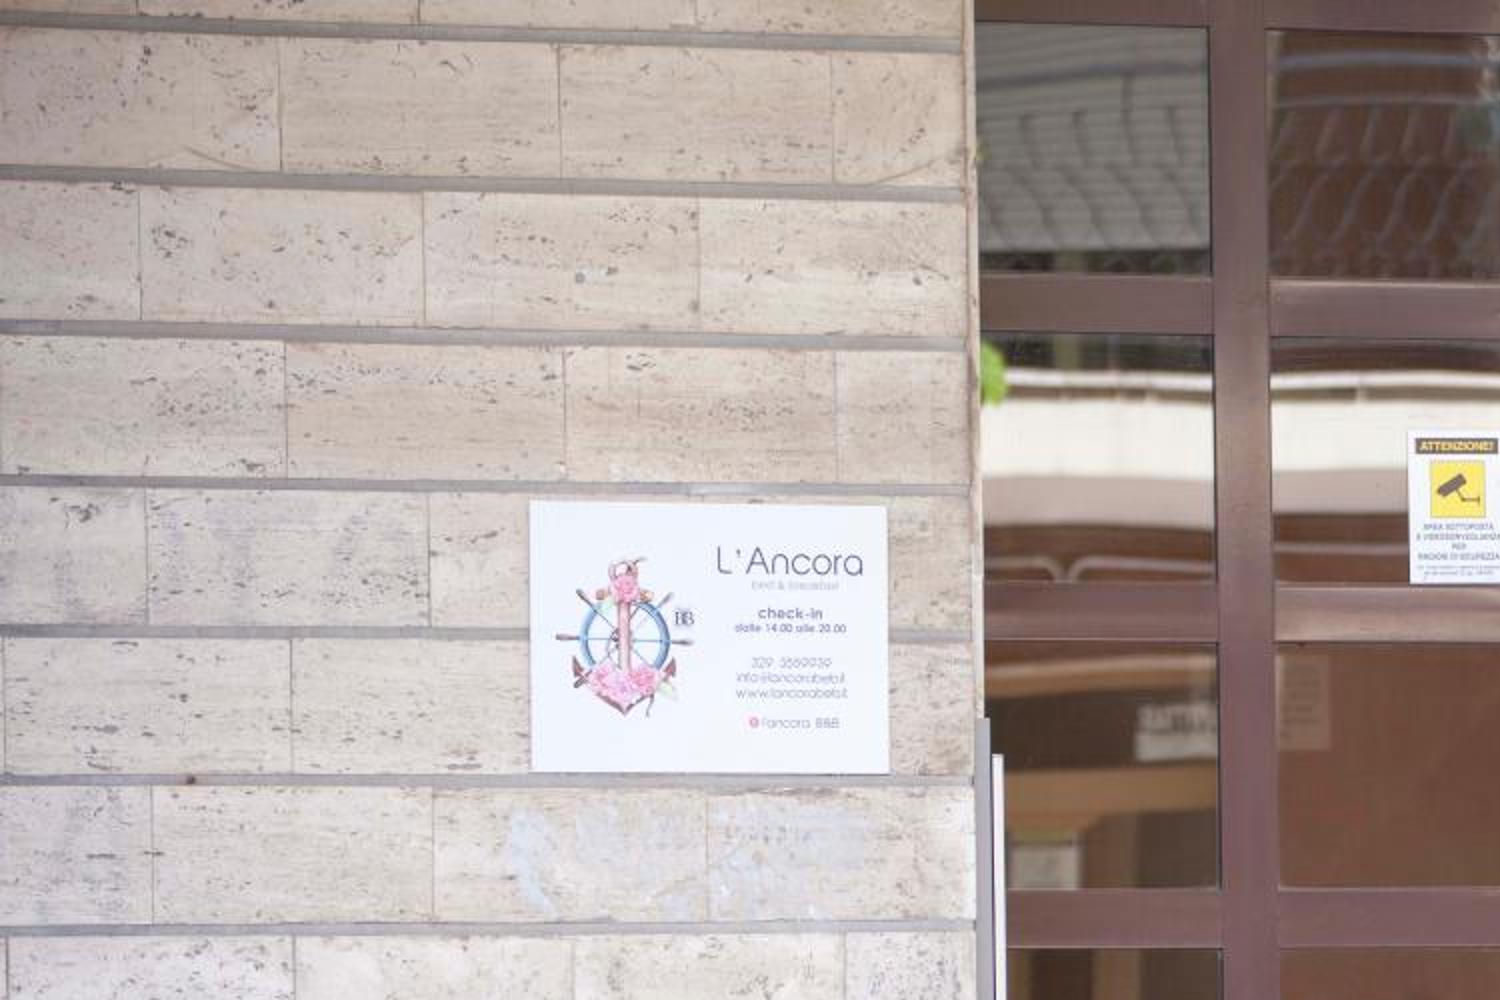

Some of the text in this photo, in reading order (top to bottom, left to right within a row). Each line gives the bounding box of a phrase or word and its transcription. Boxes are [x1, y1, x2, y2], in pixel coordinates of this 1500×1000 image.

[717, 546, 864, 577] L'Ancora
[758, 607, 823, 620] check-in
[735, 623, 847, 633] dalle 14.00 alle 20.00
